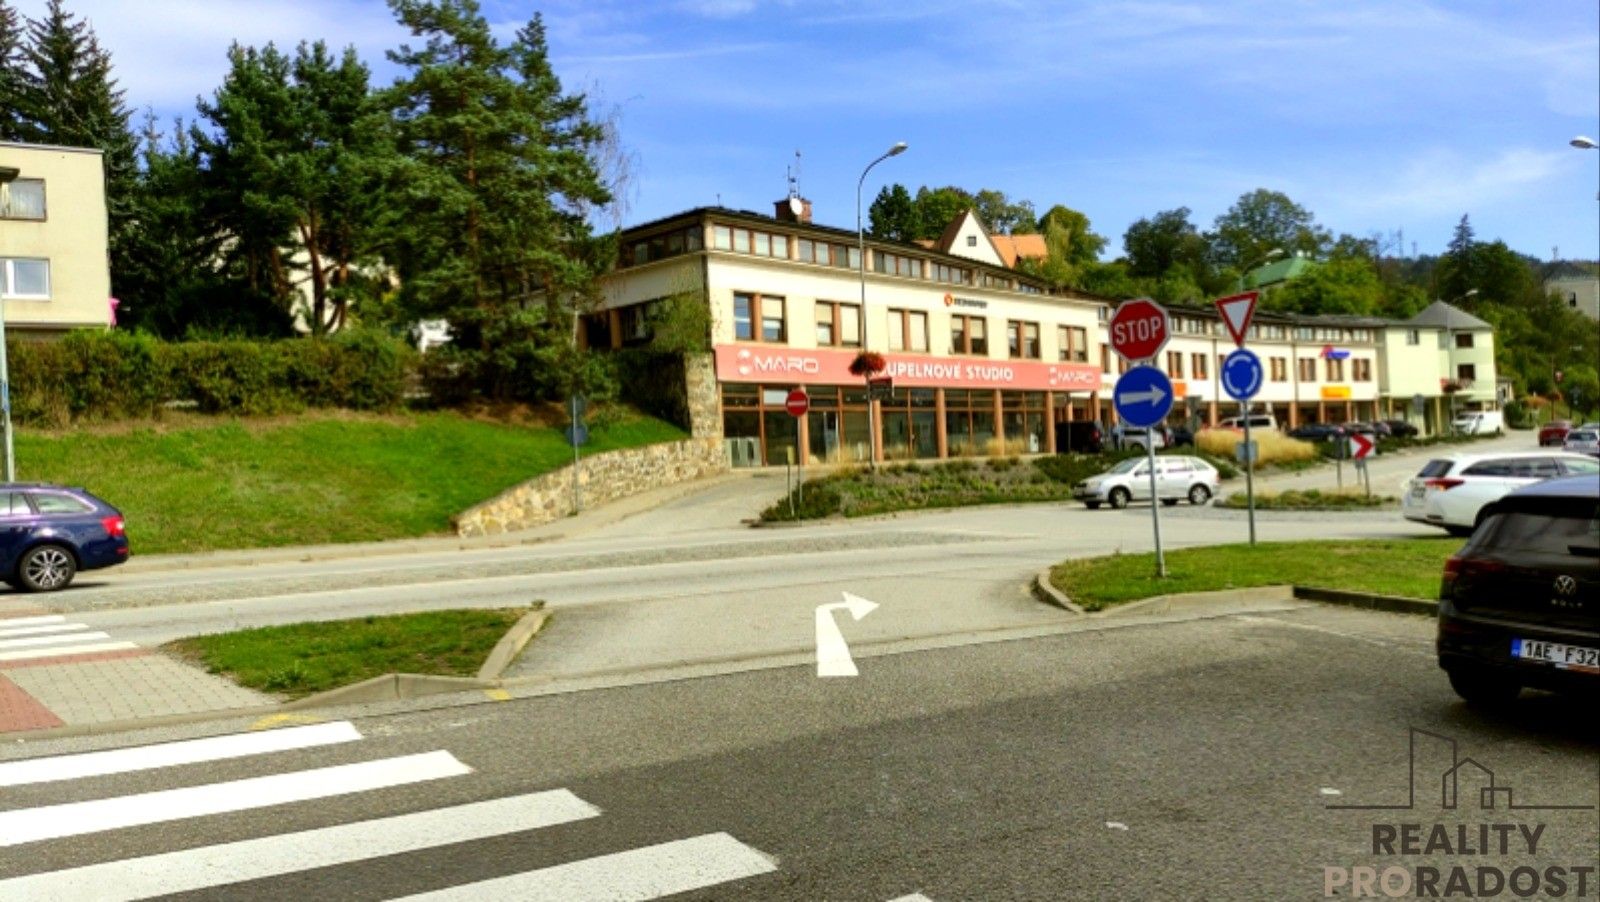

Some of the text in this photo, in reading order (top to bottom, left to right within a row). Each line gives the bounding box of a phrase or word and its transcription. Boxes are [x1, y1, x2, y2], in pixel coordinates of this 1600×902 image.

[1114, 316, 1161, 345] STOP
[753, 356, 819, 374] MARO
[873, 362, 1013, 381] UPELNOVÉ STUDIO
[1525, 641, 1552, 660] 1AE
